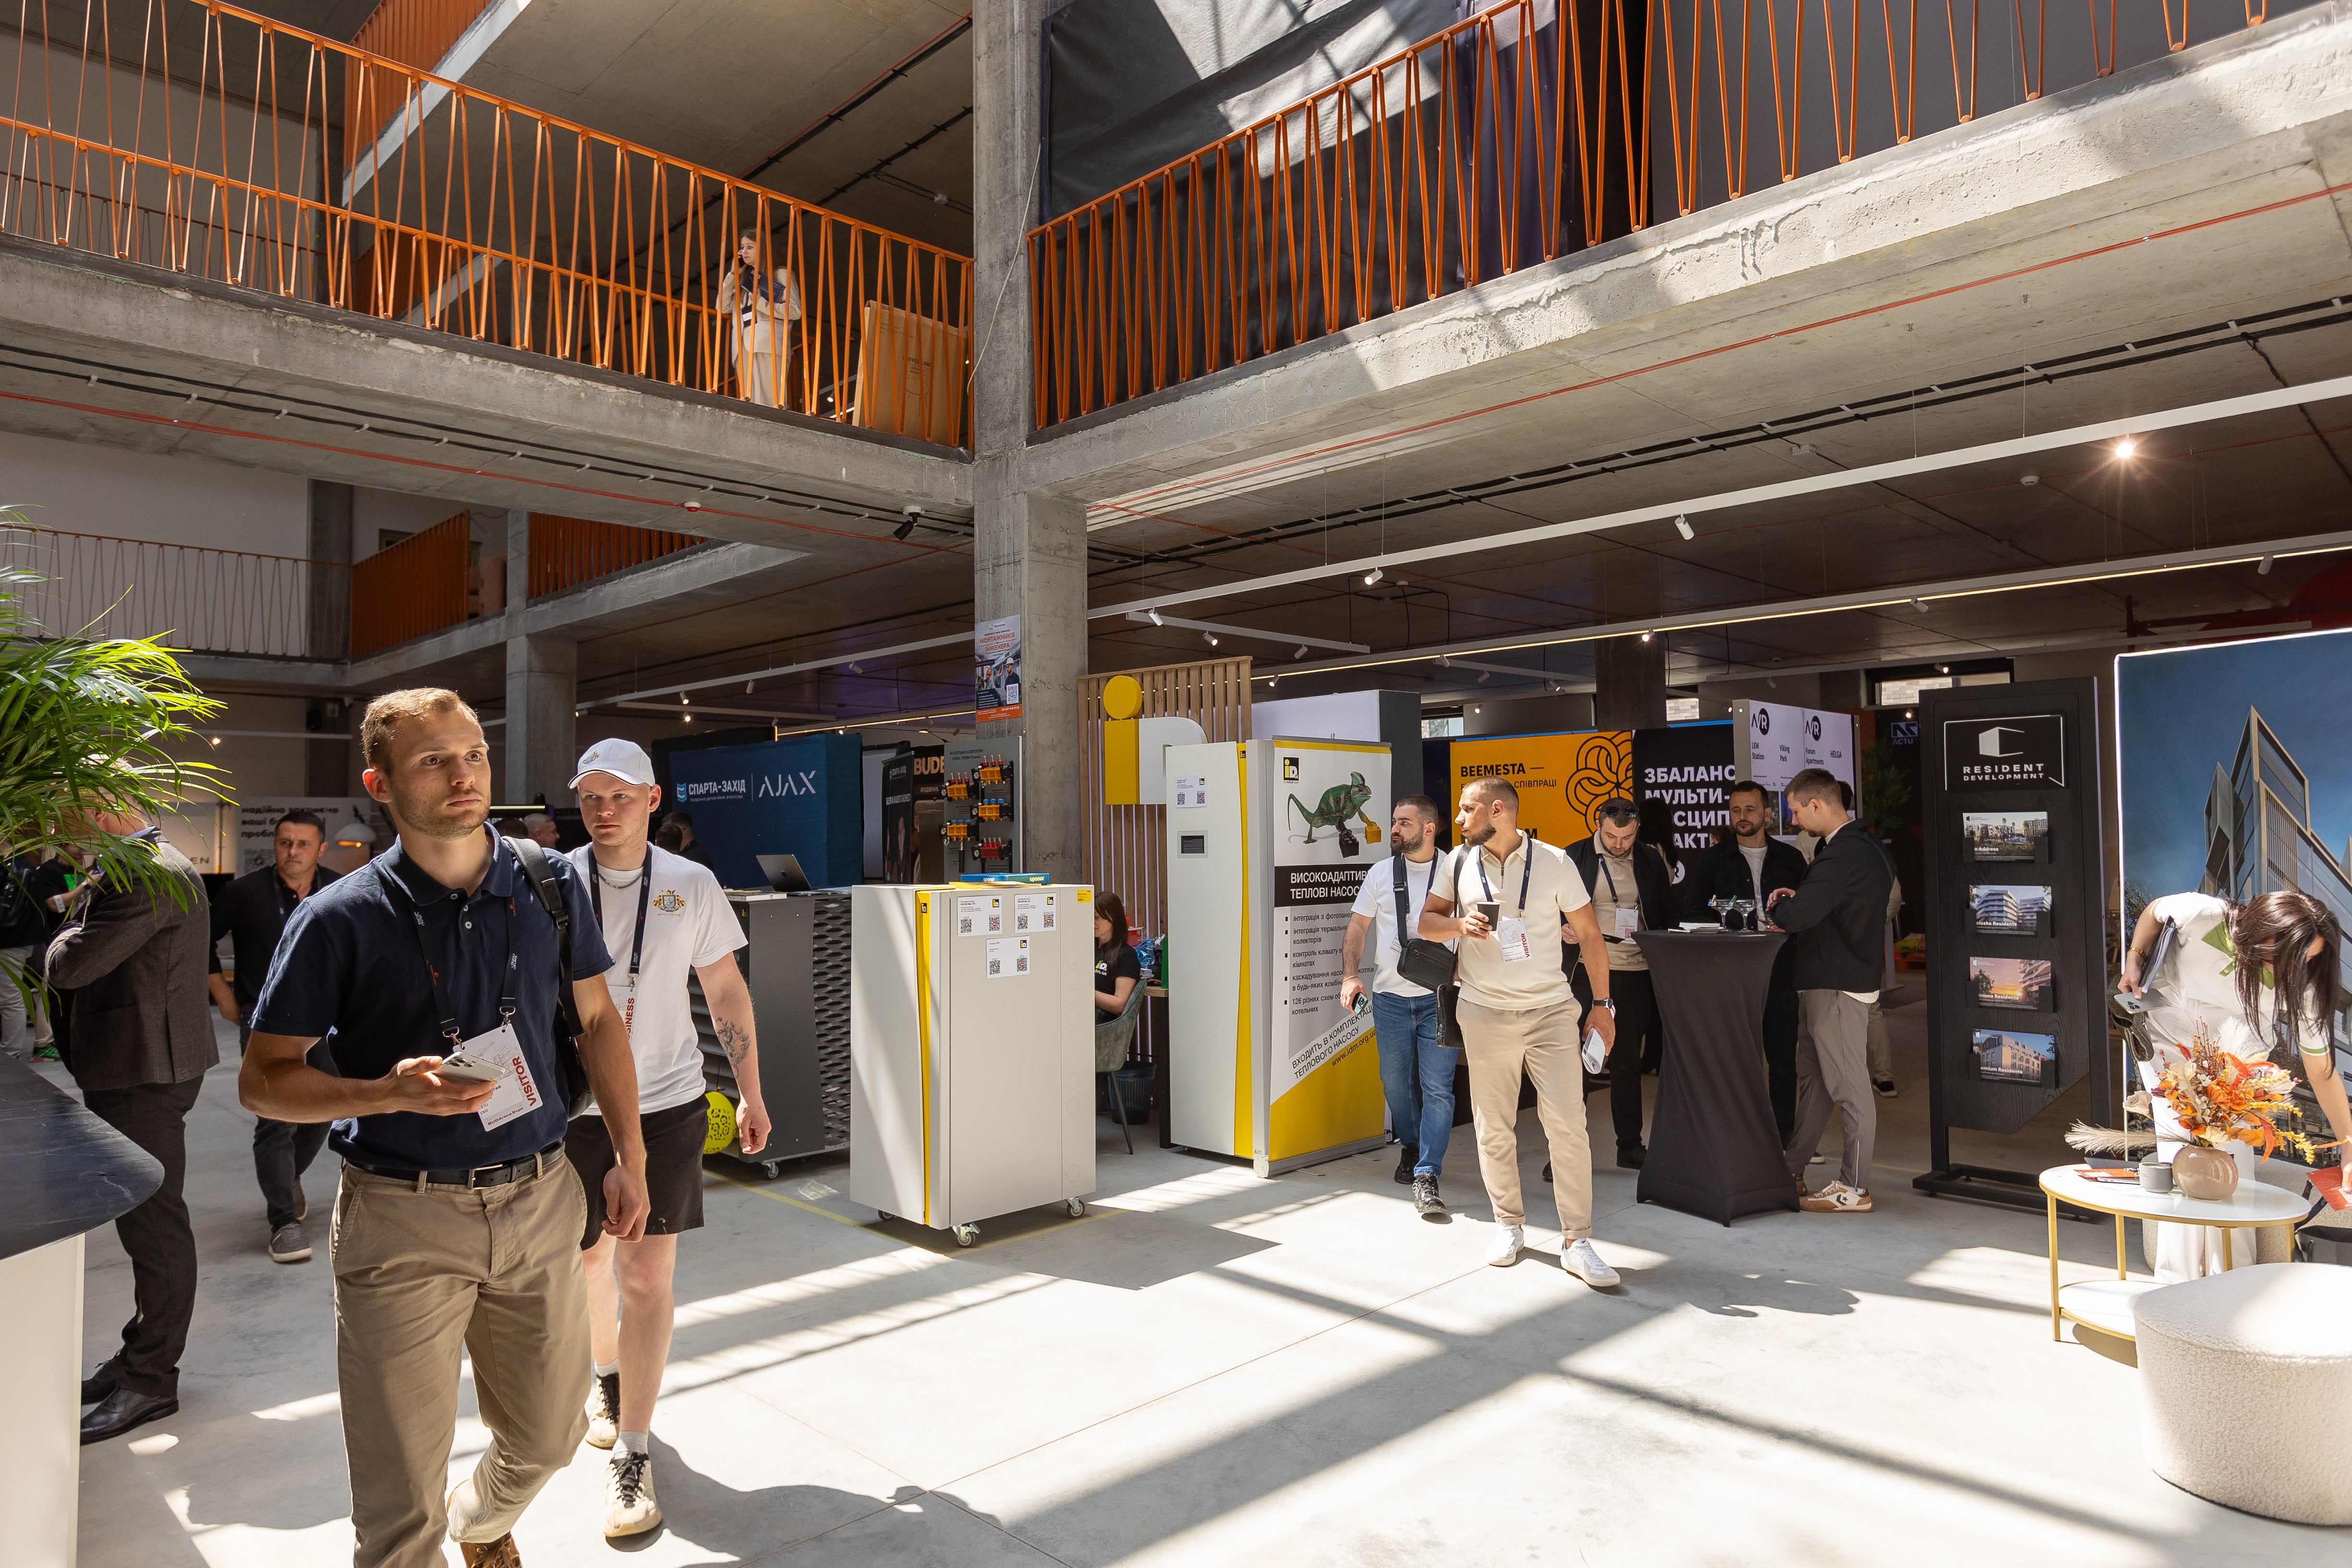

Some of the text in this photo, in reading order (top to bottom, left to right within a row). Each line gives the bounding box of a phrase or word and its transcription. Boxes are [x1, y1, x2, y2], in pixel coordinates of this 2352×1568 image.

[980, 632, 1015, 644] МОНТАЖНИКІВ
[985, 643, 1010, 652] ІНЖЕНЕРА
[1779, 745, 1790, 754] Viking
[1830, 750, 1842, 758] HELGA
[1461, 763, 1526, 777] BEEMESTA
[1644, 765, 1735, 783] ЗБАЛАНС
[1963, 764, 2044, 774] RESIDENT
[689, 779, 746, 795] СПАРТА-ЗАХІД
[758, 770, 816, 798] AJAX
[1514, 779, 1557, 788] СПІВПРАЦІ
[1673, 811, 1730, 829] СЦИП
[1673, 833, 1713, 849] АКТ
[1291, 870, 1369, 884] ВИСОКОАДАПТИВ
[1290, 886, 1362, 899] ТЕПЛОВІ НАСОС
[1294, 913, 1320, 922] інтеграція
[1325, 912, 1353, 921] фотопанел
[1293, 925, 1348, 935] інтеграція термальни
[1293, 936, 1321, 945] колекторів
[1521, 933, 1530, 958] VISITOR
[1293, 949, 1317, 958] контроль
[1292, 970, 1329, 981] каскадування
[1358, 966, 1374, 974] котлів
[1297, 982, 1323, 992] будь-яких
[1302, 996, 1320, 1005] різних
[625, 997, 635, 1038] SINESS
[1292, 1007, 1319, 1015] котельних
[1292, 1042, 1322, 1069] ВХОДИТЬ
[1323, 1037, 1328, 1045] В
[1294, 1025, 1359, 1080] ТЕПЛОВОГО НАСОСУ
[512, 1056, 537, 1107] VISITOR
[487, 1112, 512, 1126] BUDArena
